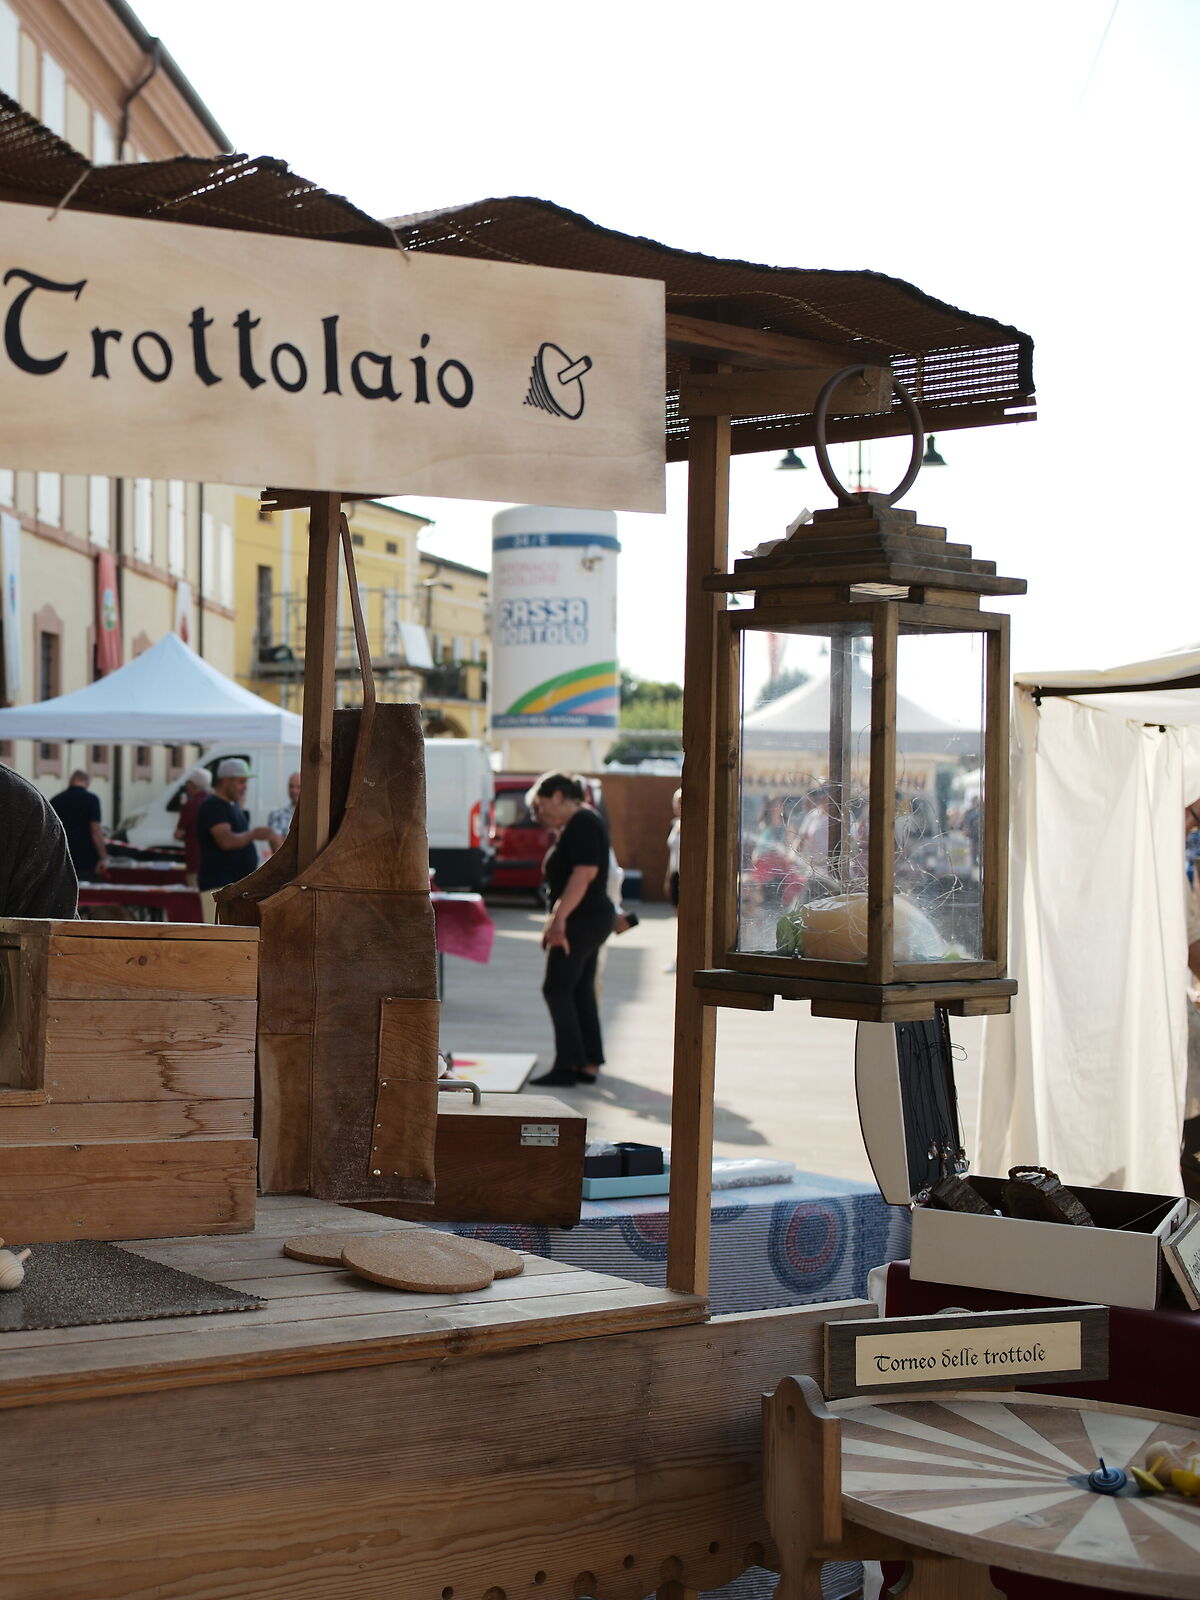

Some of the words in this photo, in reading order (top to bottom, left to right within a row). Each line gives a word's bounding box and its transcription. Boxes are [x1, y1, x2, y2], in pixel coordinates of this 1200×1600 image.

[3, 267, 474, 409] Trottolaio
[873, 1353, 937, 1373] Torneo
[941, 1347, 979, 1368] delle
[983, 1342, 1046, 1364] trottole
